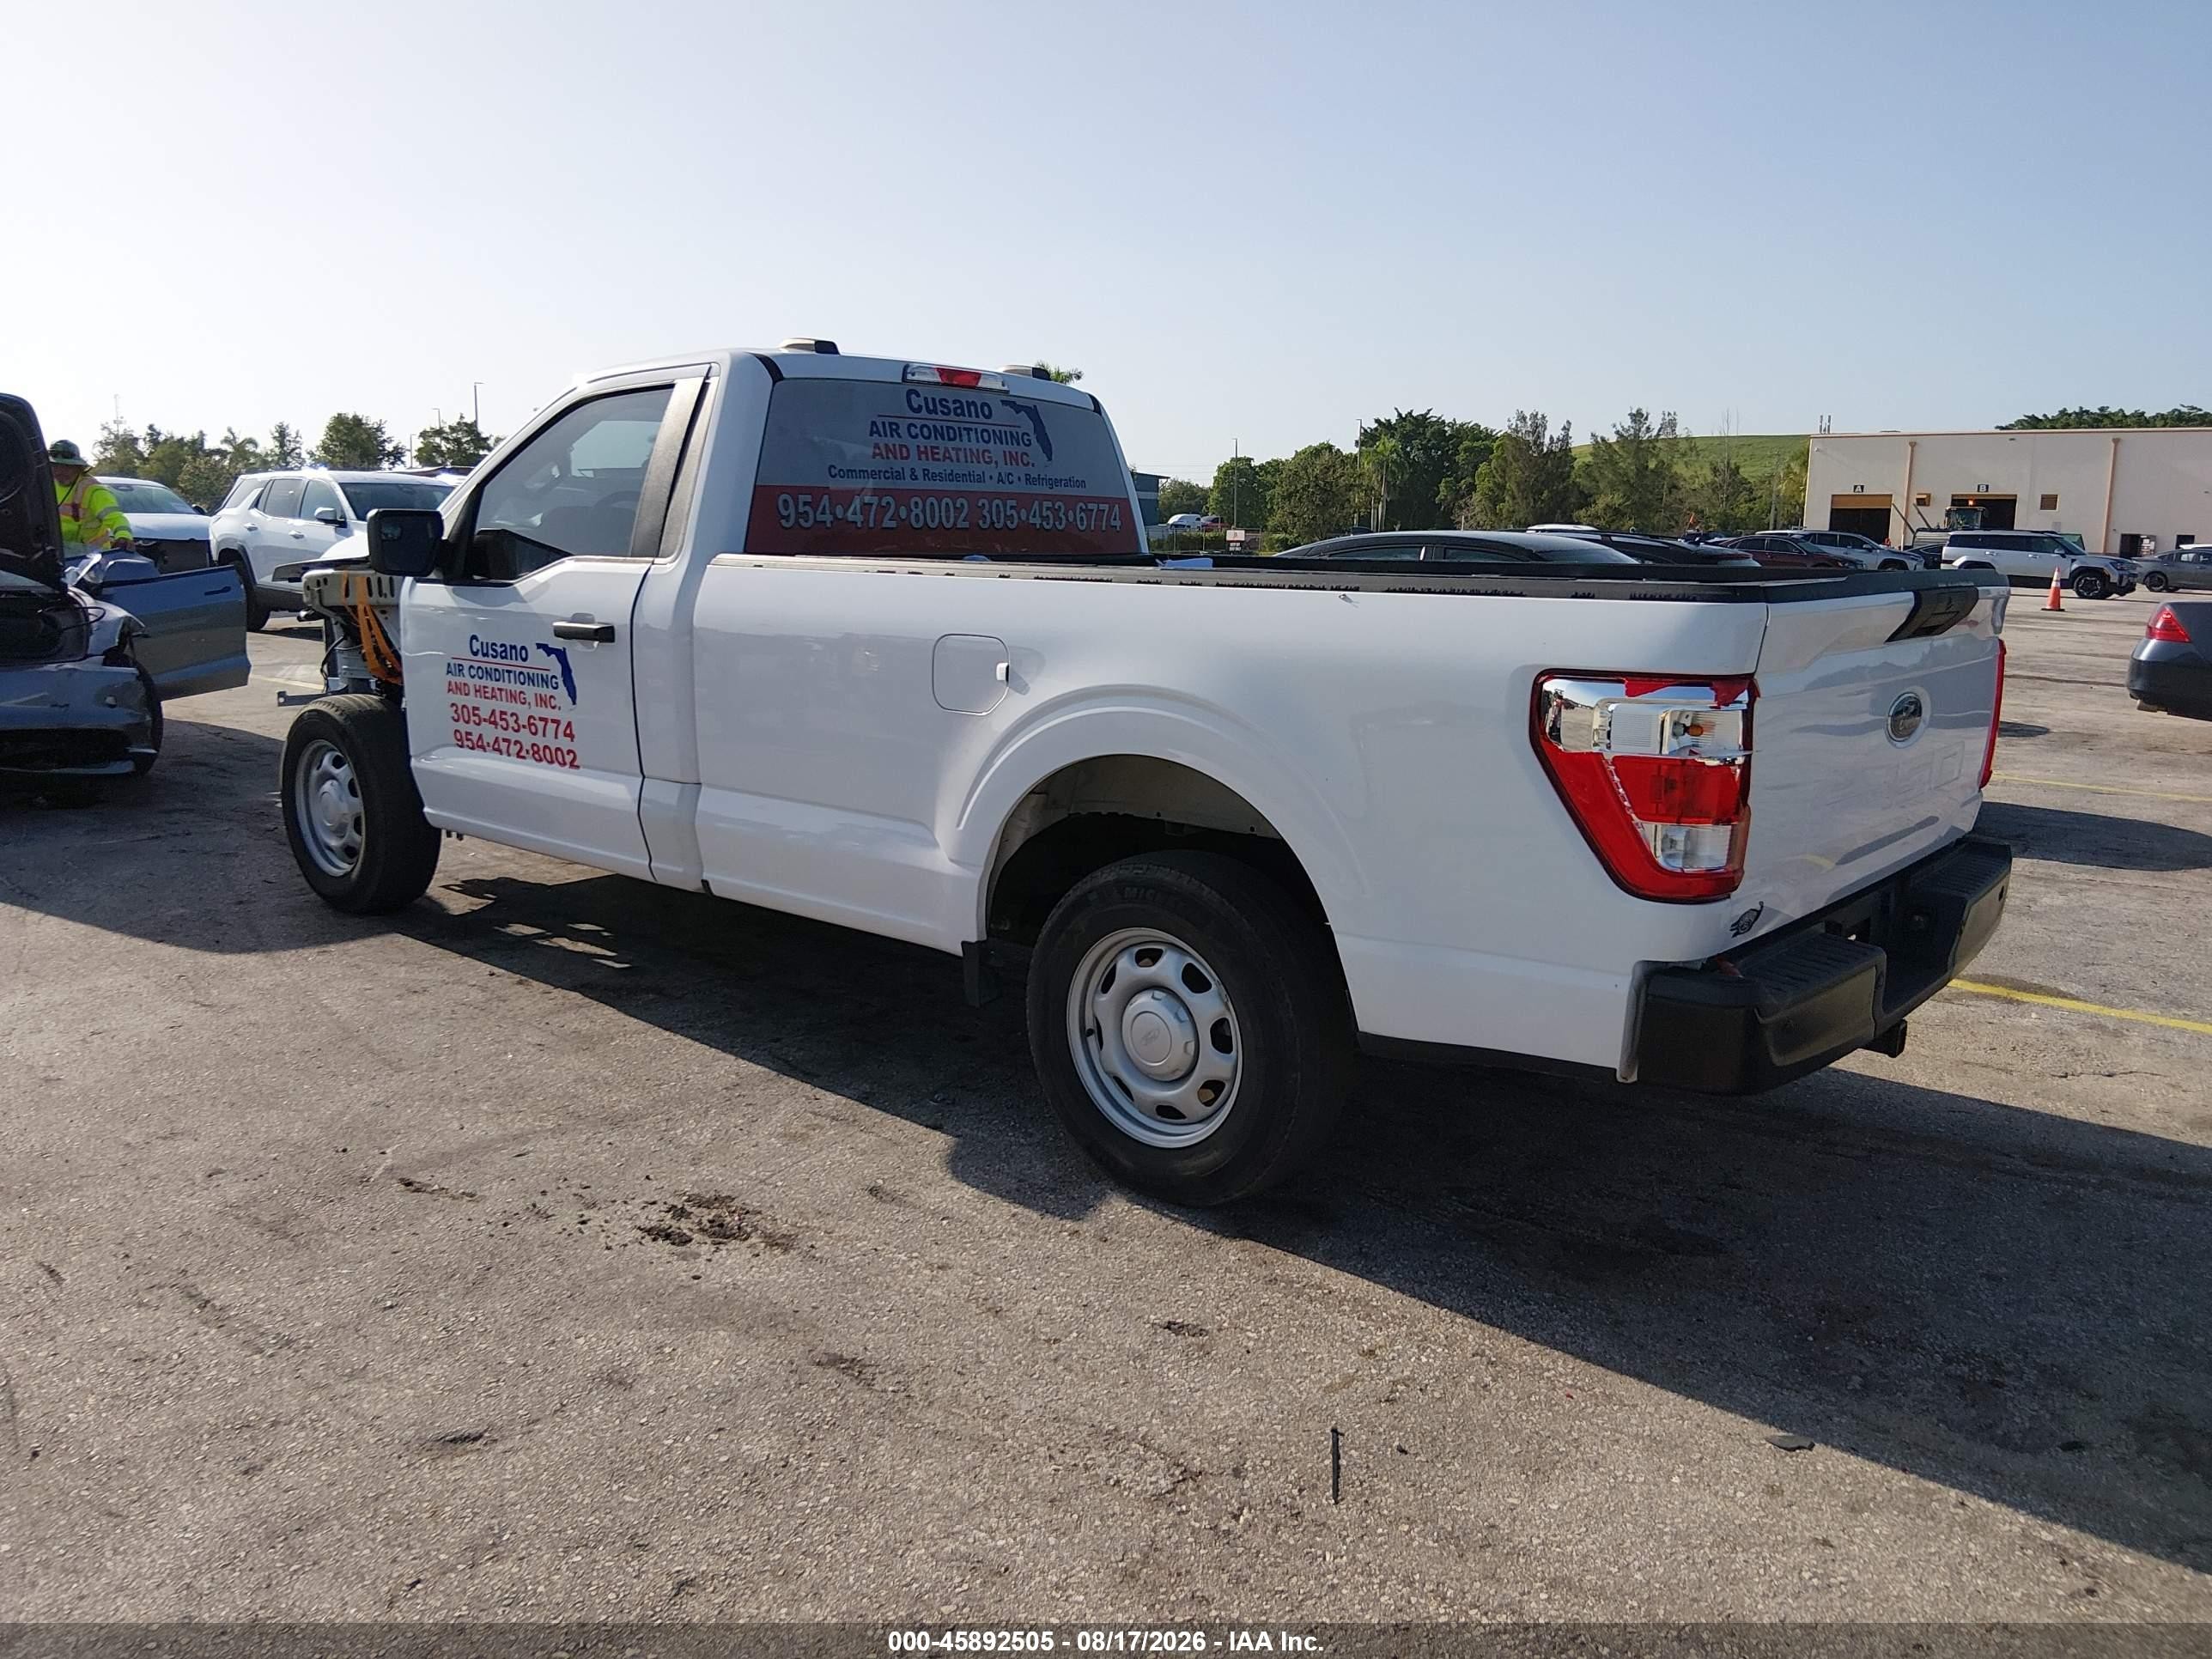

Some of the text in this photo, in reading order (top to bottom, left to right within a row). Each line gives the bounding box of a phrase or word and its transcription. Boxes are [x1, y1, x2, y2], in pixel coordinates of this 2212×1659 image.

[906, 389, 993, 419] Cusano
[869, 420, 1031, 447] AIR CONDITIONING
[872, 442, 1036, 468] AND HEATING, INC.
[828, 465, 906, 482] Commercial
[909, 467, 919, 480] &
[923, 468, 986, 483] Residential
[997, 472, 1014, 485] A/C
[1024, 473, 1086, 489] Refrigeration
[469, 635, 529, 662] Cusano
[446, 662, 559, 690] AIR CONDITIONING
[447, 680, 562, 711] AND HEATING, INC.
[450, 702, 575, 742] 305-453-6774
